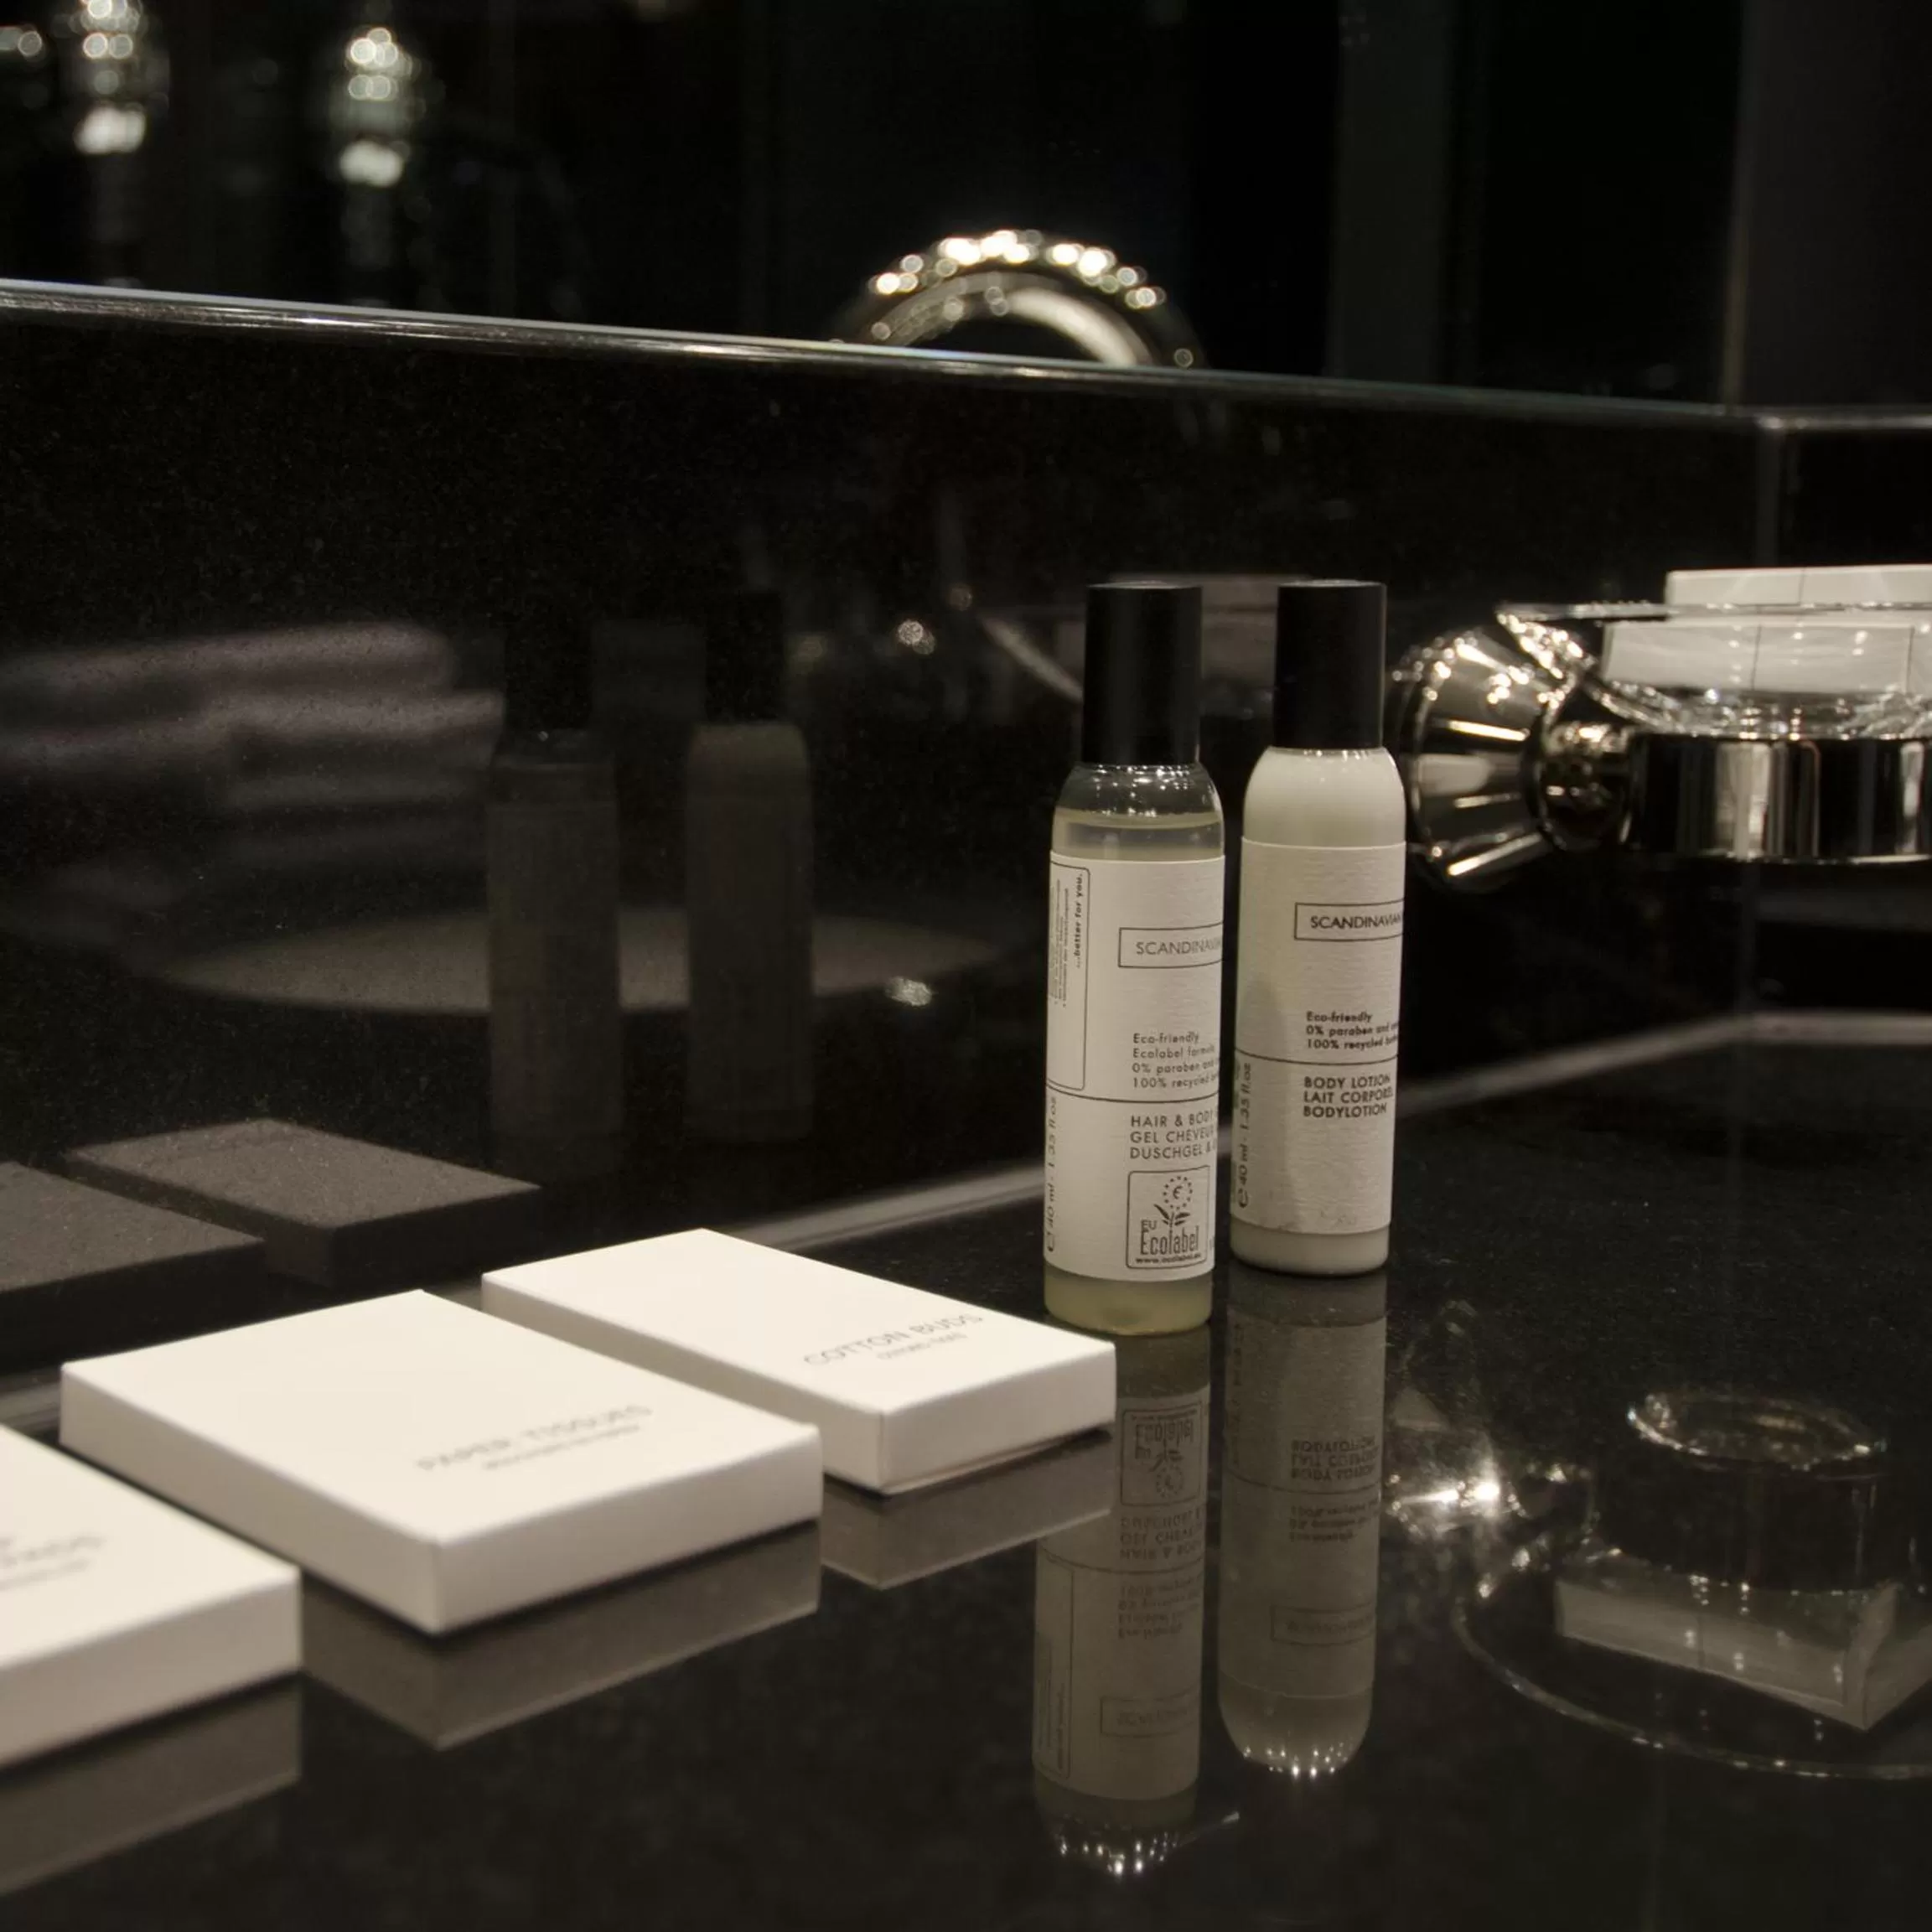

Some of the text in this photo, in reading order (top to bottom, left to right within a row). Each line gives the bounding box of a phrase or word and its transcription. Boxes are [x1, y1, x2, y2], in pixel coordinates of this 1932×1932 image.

[1074, 900, 1082, 918] for
[1306, 1010, 1373, 1023] Eco-friendly
[1132, 1030, 1199, 1045] Eco-friendly
[1307, 1024, 1324, 1036] 0%
[1329, 1025, 1373, 1038] paraben
[1308, 1039, 1339, 1049] 100%
[1343, 1037, 1383, 1051] recycled
[1132, 1046, 1184, 1059] Ecolabel
[1132, 1062, 1152, 1074] 0%
[1156, 1062, 1200, 1076] paraben
[1132, 1076, 1168, 1089] 100%
[1304, 1074, 1391, 1089] BODY LOTION
[1303, 1090, 1334, 1104] LAIT
[1303, 1103, 1387, 1118] BODYLOTION
[1130, 1114, 1168, 1127] HAIR
[1173, 1113, 1184, 1127] &
[1130, 1131, 1159, 1143] GEL
[1130, 1142, 1203, 1159] DUSCHGEL
[1141, 1225, 1199, 1255] Ecolabel
